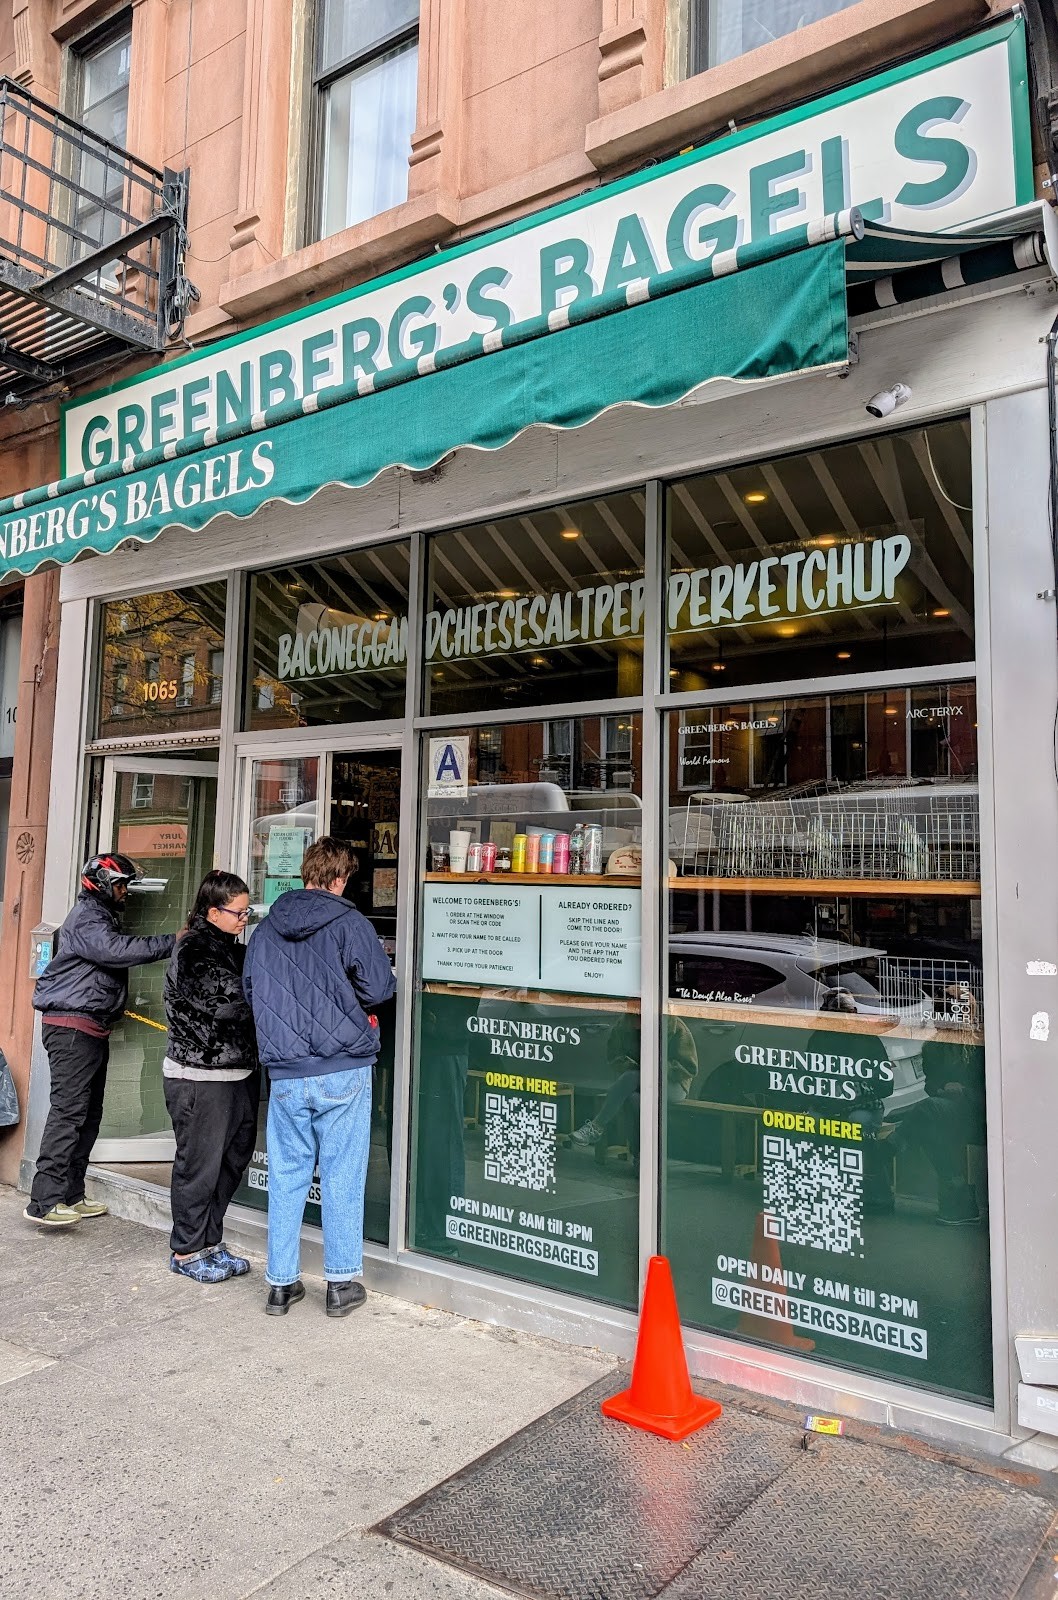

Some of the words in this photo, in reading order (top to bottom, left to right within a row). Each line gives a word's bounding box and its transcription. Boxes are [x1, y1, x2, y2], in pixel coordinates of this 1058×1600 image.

[81, 266, 513, 473] GREENBERG'S
[540, 95, 978, 317] BAGELS
[124, 440, 275, 526] BAGELS
[142, 680, 178, 702] 1065
[678, 721, 739, 735] GREENBERG'S
[741, 720, 777, 730] BAGELS
[436, 744, 461, 781] A
[679, 755, 701, 766] World
[702, 755, 730, 766] Famous
[432, 897, 462, 905] WELCOME
[473, 898, 521, 907] GREENBERG'S!
[558, 901, 591, 910] ALREADY
[592, 902, 633, 912] ORDERED?
[502, 935, 521, 943] CALLED
[603, 926, 623, 934] DOOR!
[559, 939, 579, 947] PLEASE
[611, 942, 628, 950] NAME
[605, 949, 619, 957] THAT
[489, 963, 514, 972] PATIENCE!
[579, 955, 605, 964] ORDERED
[606, 957, 623, 965] FROM
[583, 971, 604, 979] ENJOY!
[692, 988, 714, 1003] Dough
[714, 990, 732, 1002] Also
[960, 980, 971, 1014] CLIMB
[951, 998, 961, 1013] OF
[921, 1010, 971, 1025] SUMMER
[466, 1015, 581, 1046] GREENBERG'S
[490, 1038, 554, 1063] BAGELS
[734, 1044, 894, 1082] GREENBERG'S
[485, 1071, 525, 1091] ORDER
[526, 1077, 557, 1097] HERE
[768, 1070, 856, 1101] BAGELS
[762, 1110, 816, 1134] ORDER
[819, 1118, 863, 1142] HERE
[252, 1150, 268, 1166] OPE
[450, 1195, 480, 1216] OPEN
[482, 1202, 515, 1223] DAILY
[518, 1211, 545, 1232] 8AM
[546, 1217, 563, 1236] till
[565, 1222, 593, 1243] 3PM
[448, 1219, 596, 1271] @GREENBERGSBAGELS
[716, 1254, 758, 1280] OPEN
[761, 1264, 807, 1291] DAILY
[813, 1276, 850, 1302] 8AM
[853, 1286, 876, 1308] till
[879, 1292, 919, 1319] 3PM
[714, 1283, 923, 1353] @GREENBERGSBAGELS
